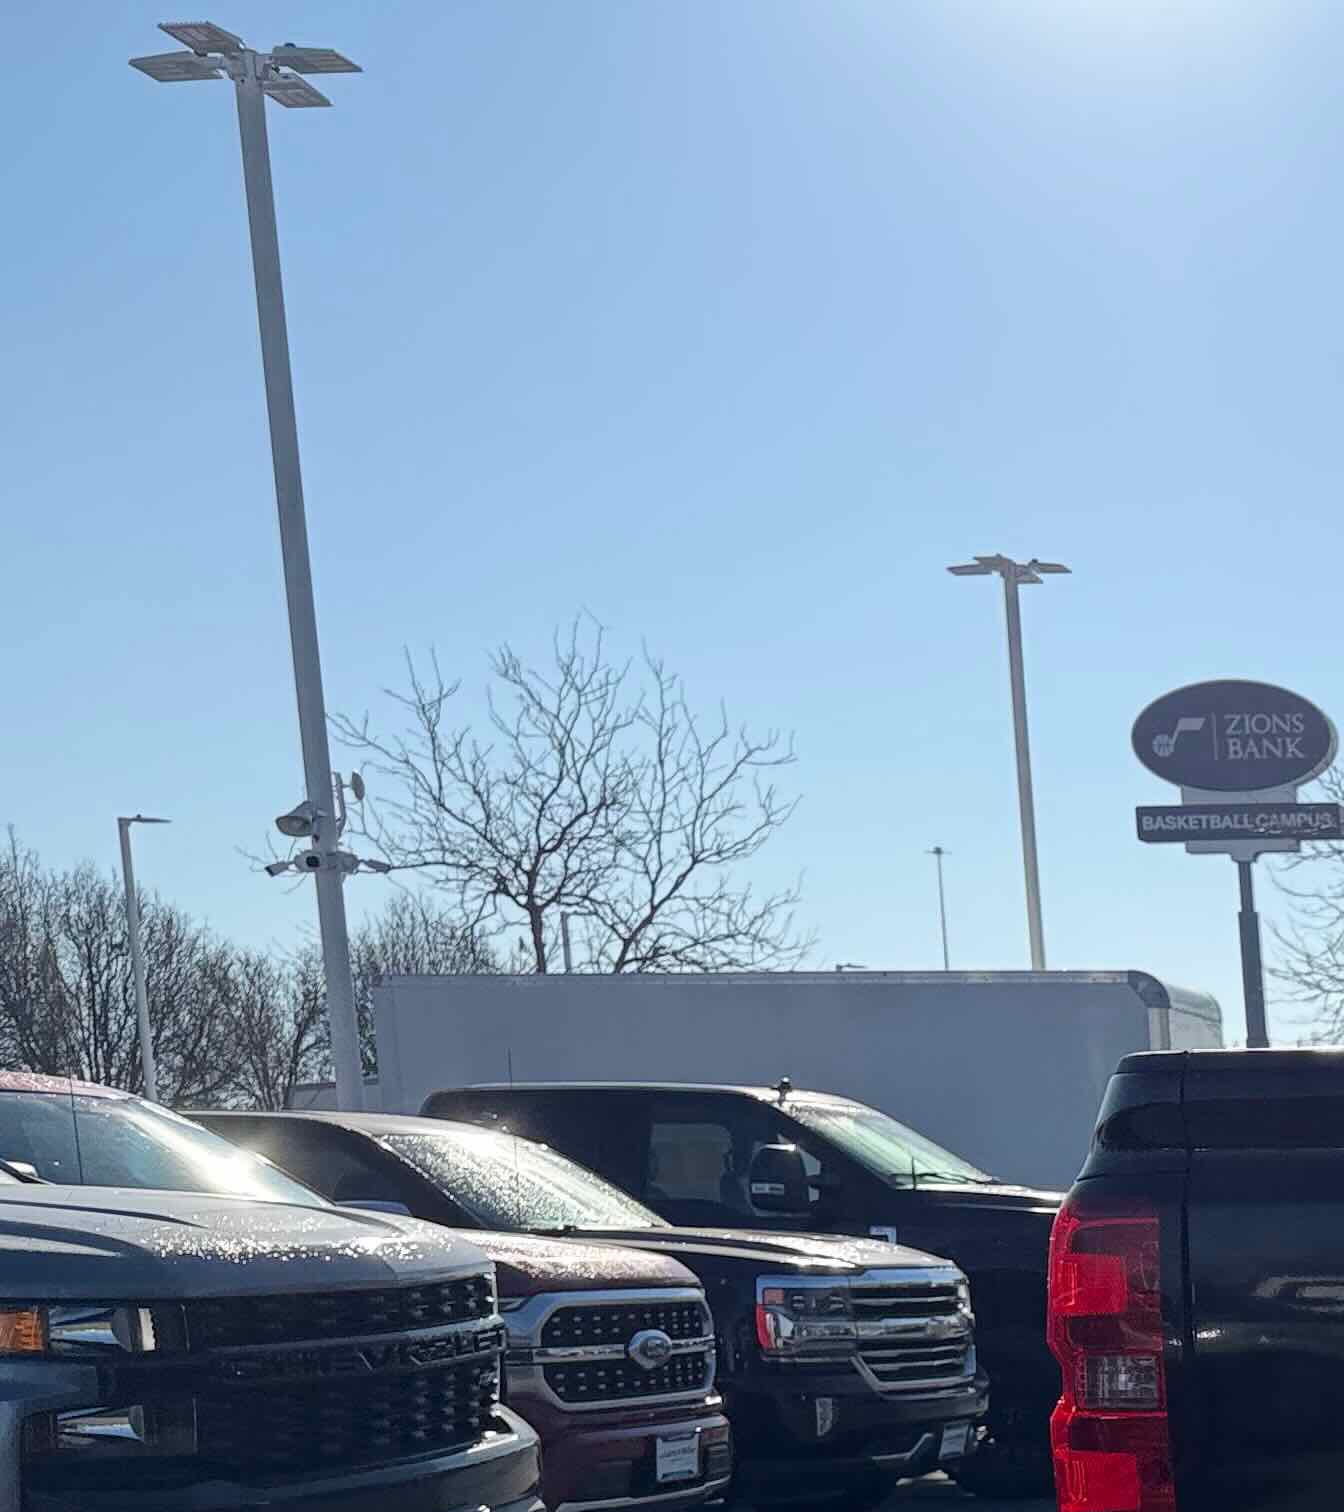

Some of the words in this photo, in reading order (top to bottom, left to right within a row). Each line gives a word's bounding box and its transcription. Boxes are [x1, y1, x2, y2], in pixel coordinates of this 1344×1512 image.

[1223, 713, 1305, 735] ZIONS
[1227, 737, 1305, 760] BANK
[1141, 813, 1253, 831] BASKETBALL
[1255, 813, 1336, 829] CAMPUS
